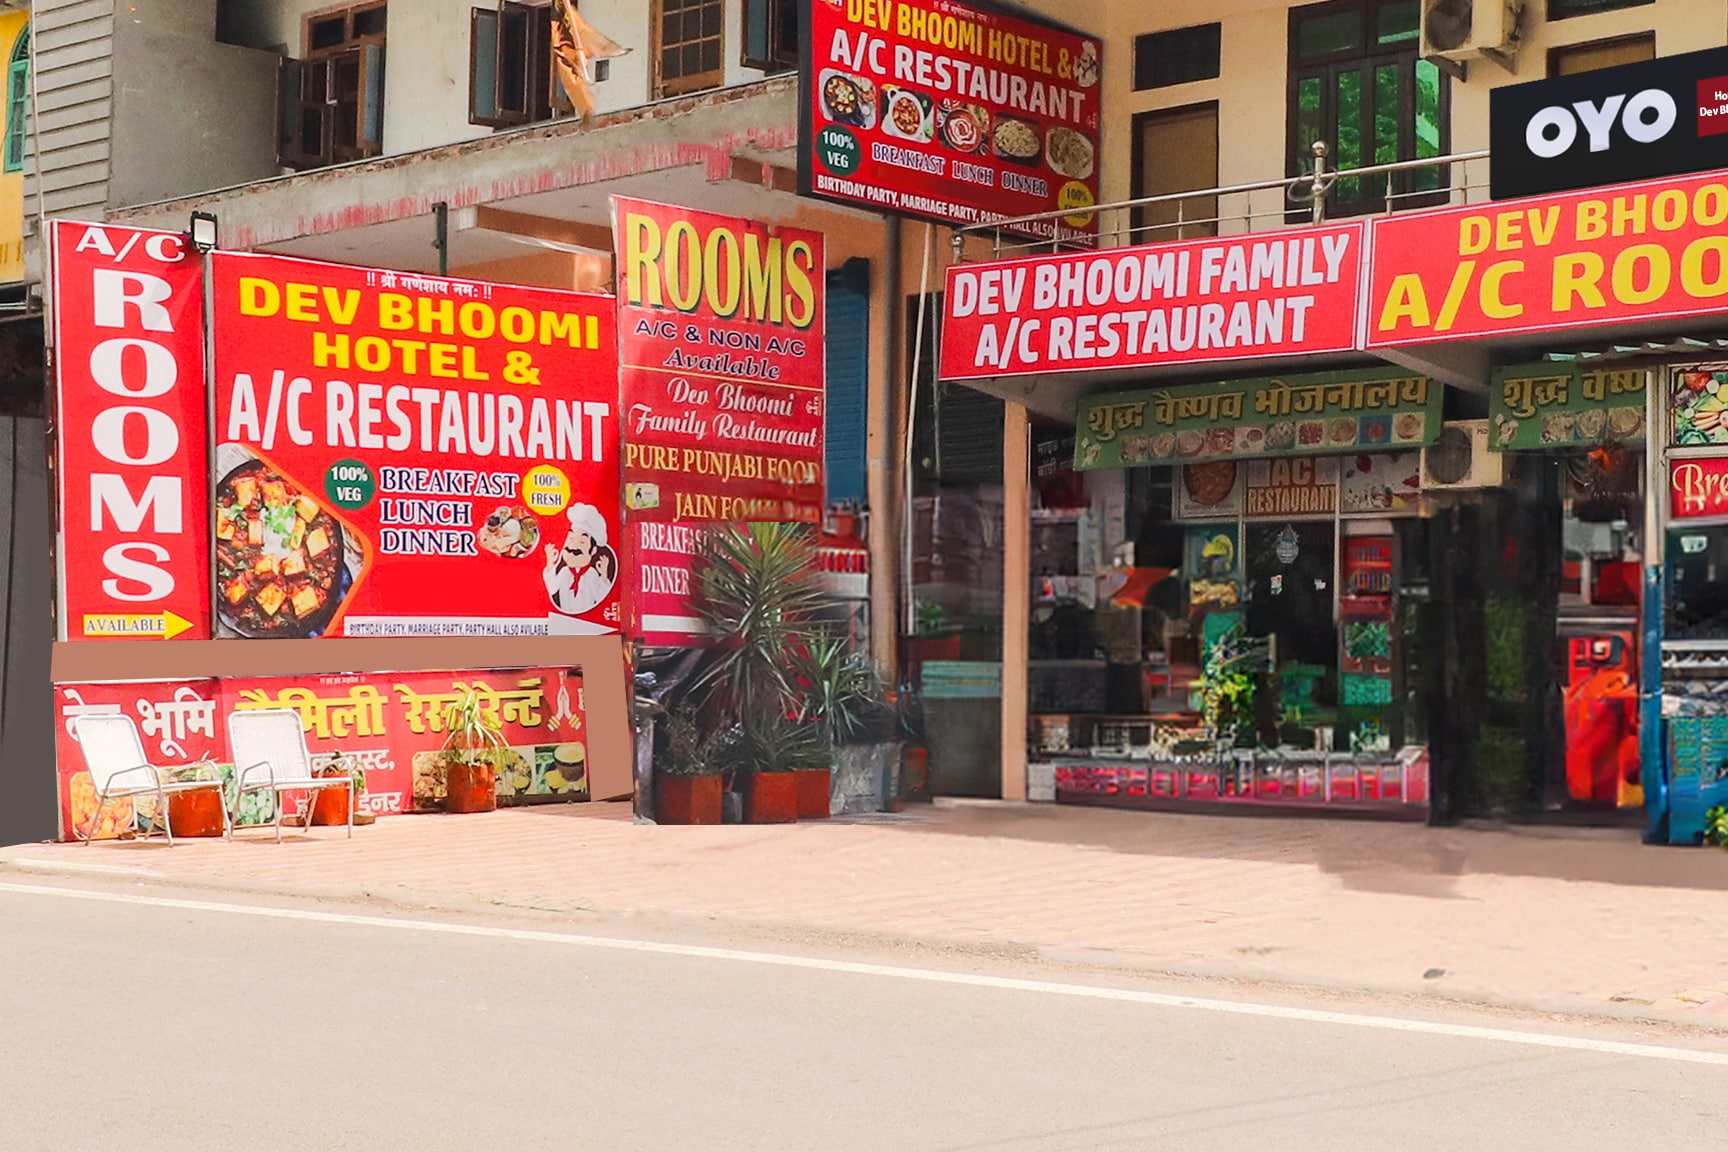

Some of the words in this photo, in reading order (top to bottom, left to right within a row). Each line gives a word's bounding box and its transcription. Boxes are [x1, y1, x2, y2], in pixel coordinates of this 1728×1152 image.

[897, 3, 984, 57] BHOOMI
[988, 27, 1053, 74] HOTEL
[1057, 47, 1073, 80] &
[830, 28, 886, 75] A/C
[894, 44, 1086, 124] RESTAURANT
[1525, 87, 1677, 159] OYO
[1699, 104, 1719, 118] Dev
[822, 129, 855, 151] 100%
[826, 152, 849, 169] VEG
[871, 142, 946, 175] BREAKFAST
[951, 160, 994, 186] LUNCH
[1002, 171, 1048, 198] DINNER
[817, 174, 865, 200] BIRTHDAY
[867, 188, 900, 208] PARTY,
[900, 194, 948, 218] MARRIAGE
[949, 203, 979, 223] PARTY,
[75, 226, 185, 263] A/C
[1458, 205, 1561, 256] DEV
[381, 271, 397, 289] श्री
[401, 276, 448, 296] गणेशाय
[625, 212, 816, 330] ROOMS
[952, 267, 1026, 318] DEV
[1034, 250, 1190, 310] BHOOMI
[1199, 233, 1350, 296] FAMILY
[239, 276, 361, 325] DEV
[378, 293, 599, 350] BHOOMI
[1377, 260, 1524, 332] A/C
[635, 319, 678, 339] A/C
[685, 325, 702, 343] &
[709, 329, 761, 351] NON
[766, 338, 806, 356] A/C
[974, 317, 1040, 369] A/C
[1048, 294, 1315, 361] RESTAURANT
[313, 331, 489, 380] HOTEL
[503, 350, 541, 385] &
[664, 348, 780, 380] Available
[667, 377, 709, 404] Dev
[715, 382, 794, 417] Bhoomi
[1088, 400, 1148, 441] शुद्ध
[1154, 390, 1246, 426] वैष्णव
[1255, 376, 1430, 419] भोजनालय
[1503, 375, 1572, 418] शुद्ध
[90, 267, 184, 602] ROOMS
[228, 370, 313, 449] A/C
[326, 380, 610, 462] RESTAURANT
[628, 403, 707, 441] Family
[712, 413, 817, 448] Restaurant
[331, 466, 368, 482] 100%
[380, 467, 520, 498] BREAKFAST
[532, 473, 561, 487] 100%
[626, 443, 679, 473] PURE
[683, 449, 763, 484] PUNJABI
[1271, 458, 1313, 486] AC
[336, 487, 362, 502] VEG
[380, 499, 472, 527] LUNCH
[530, 493, 562, 506] FRESH
[673, 492, 718, 522] JAIN
[1249, 486, 1336, 514] RESTAURANT
[380, 529, 478, 556] DINNER
[641, 564, 690, 596] DINNER
[86, 617, 166, 633] AVAILABLE
[350, 623, 382, 636] BIRTHDAY
[487, 623, 501, 636] HALL
[503, 623, 518, 636] ALSO
[136, 686, 216, 759] भूमि
